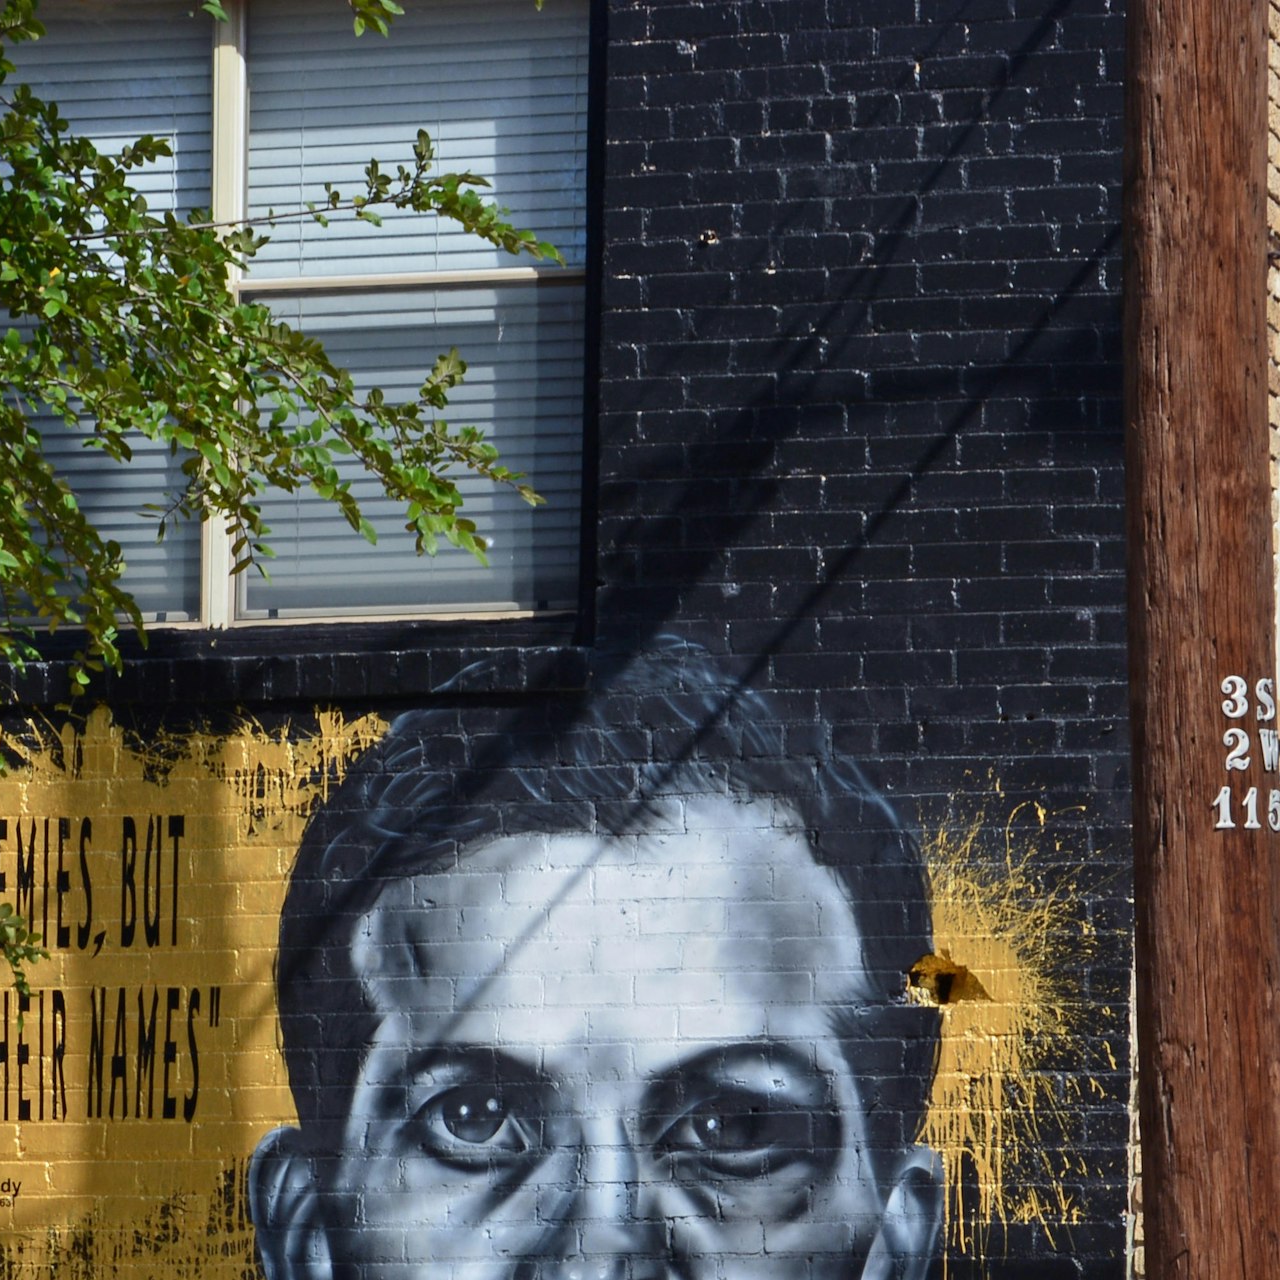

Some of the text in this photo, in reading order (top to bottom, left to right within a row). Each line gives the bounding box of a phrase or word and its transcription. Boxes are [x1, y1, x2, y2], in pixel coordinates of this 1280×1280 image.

[1220, 675, 1275, 722] 3S
[121, 813, 185, 949] BUT
[86, 984, 221, 1123] NAMES"
